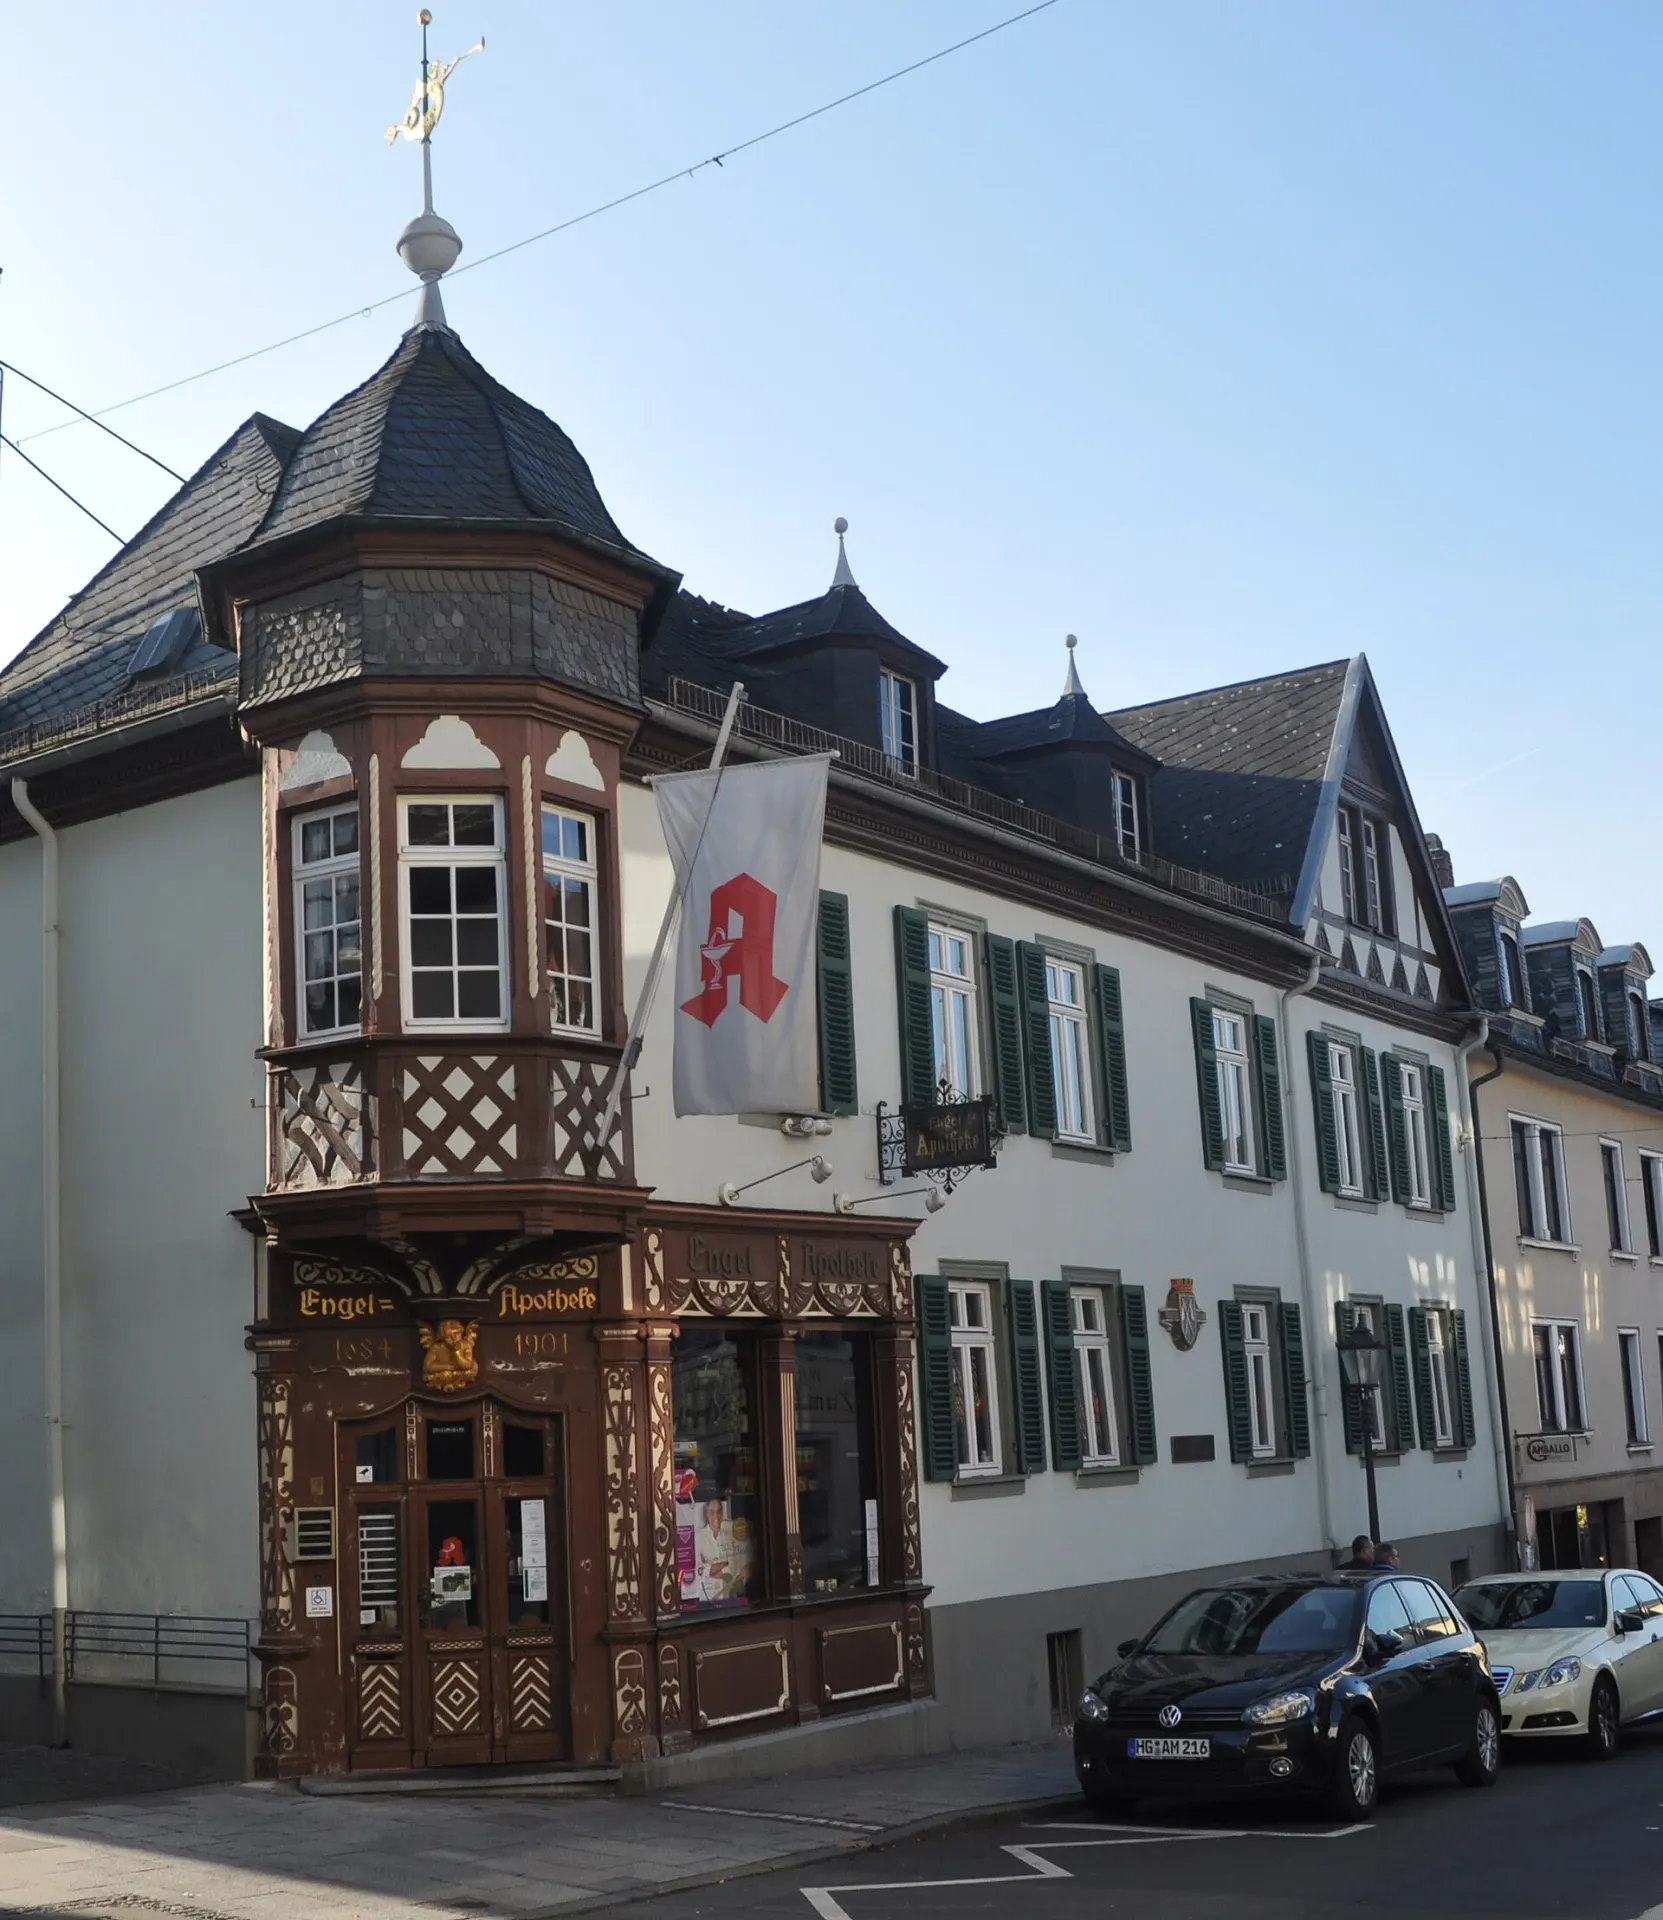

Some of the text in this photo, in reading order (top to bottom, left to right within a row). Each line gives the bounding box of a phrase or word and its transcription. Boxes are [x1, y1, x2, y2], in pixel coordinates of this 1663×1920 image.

[688, 1232, 881, 1282] Engel Apotheke
[499, 1283, 597, 1318] Apotheke
[514, 1332, 569, 1357] 1901
[1136, 1739, 1208, 1756] HG AM 216
